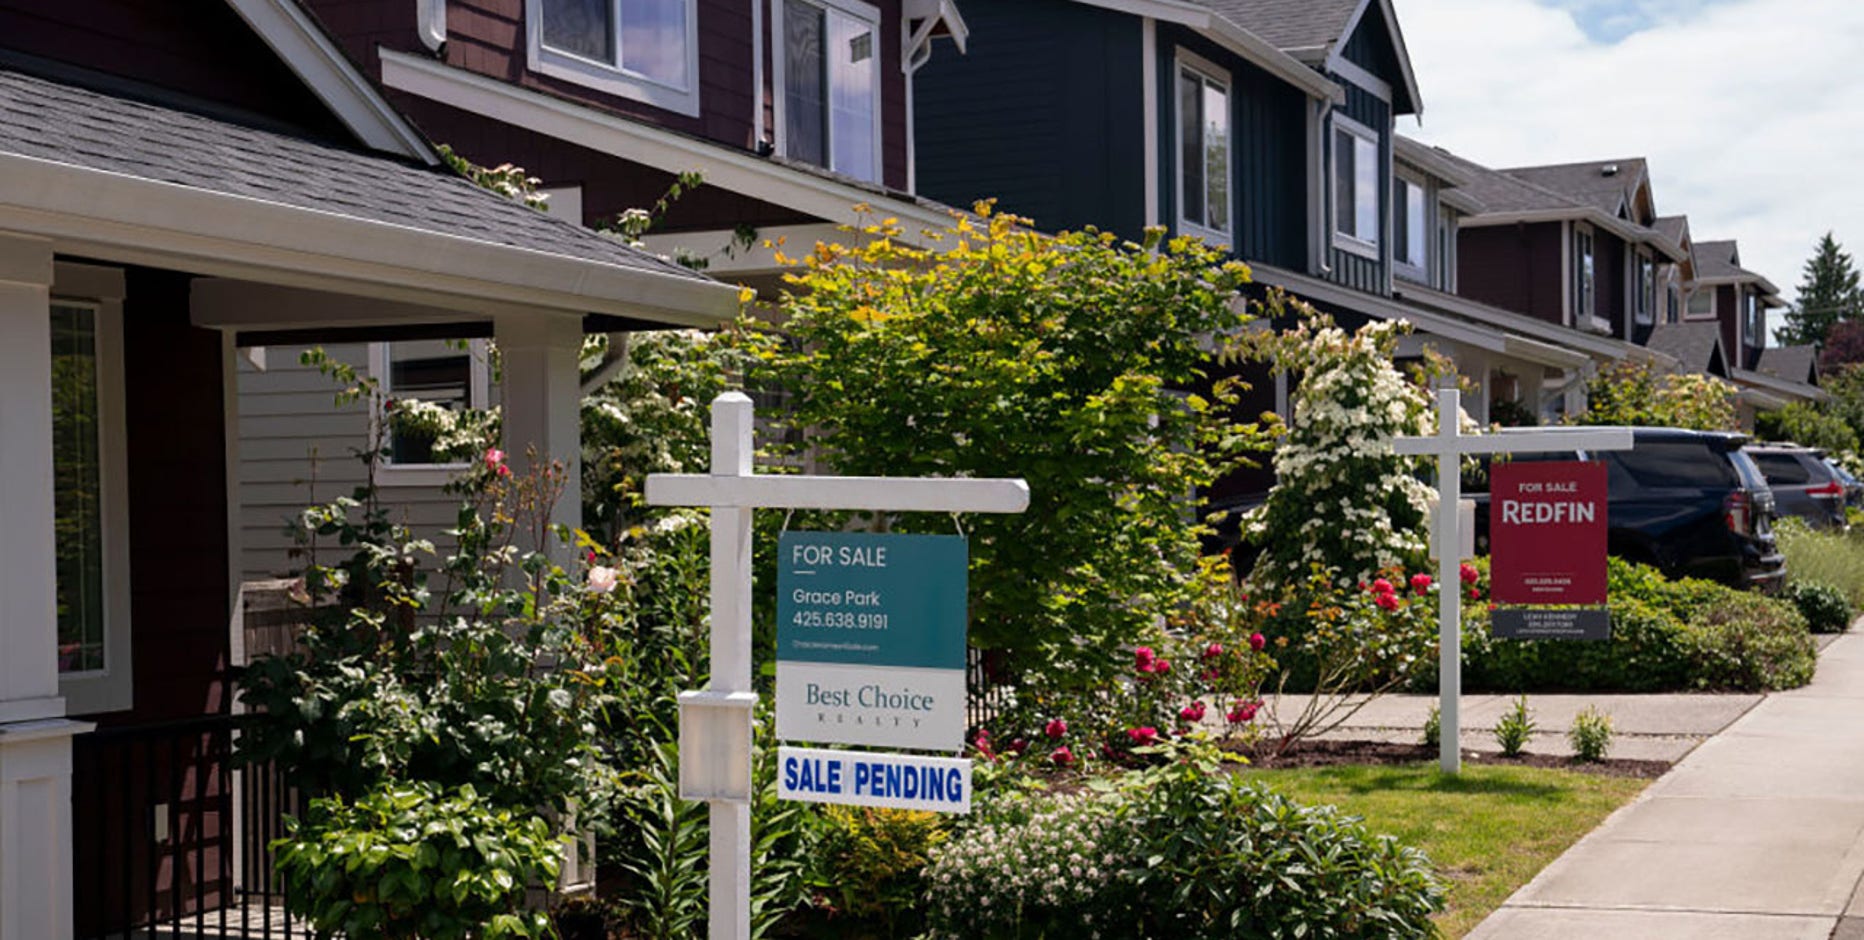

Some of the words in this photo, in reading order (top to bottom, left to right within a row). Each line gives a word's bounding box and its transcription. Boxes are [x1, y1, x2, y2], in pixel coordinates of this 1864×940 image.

[1518, 482, 1543, 493] FOR
[1545, 481, 1578, 493] SALE
[792, 545, 833, 566] FOR
[839, 546, 887, 568] SALE
[792, 588, 841, 606] Grace
[845, 590, 880, 606] Park
[792, 611, 889, 630] 425.638.9191
[806, 683, 852, 707] Best
[858, 685, 935, 711] Choice
[784, 756, 842, 794] SALE
[854, 761, 963, 803] PENDING
